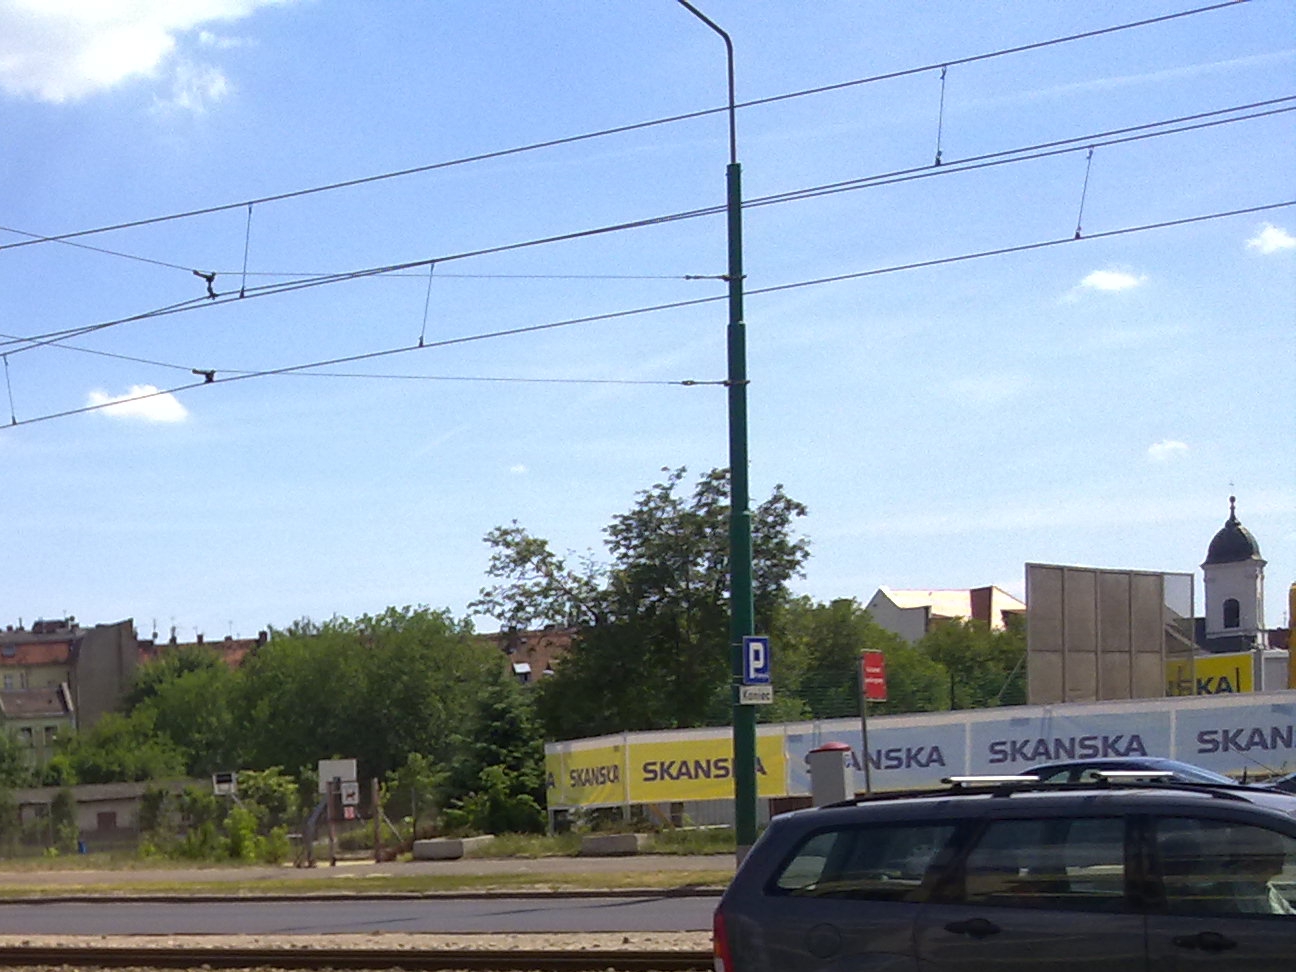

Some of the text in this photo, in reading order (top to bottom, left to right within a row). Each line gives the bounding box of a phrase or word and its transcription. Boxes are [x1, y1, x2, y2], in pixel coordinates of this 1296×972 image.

[988, 734, 1148, 764] SKANSKA
[1196, 725, 1296, 754] SKAN
[569, 764, 620, 788] SKANSKA
